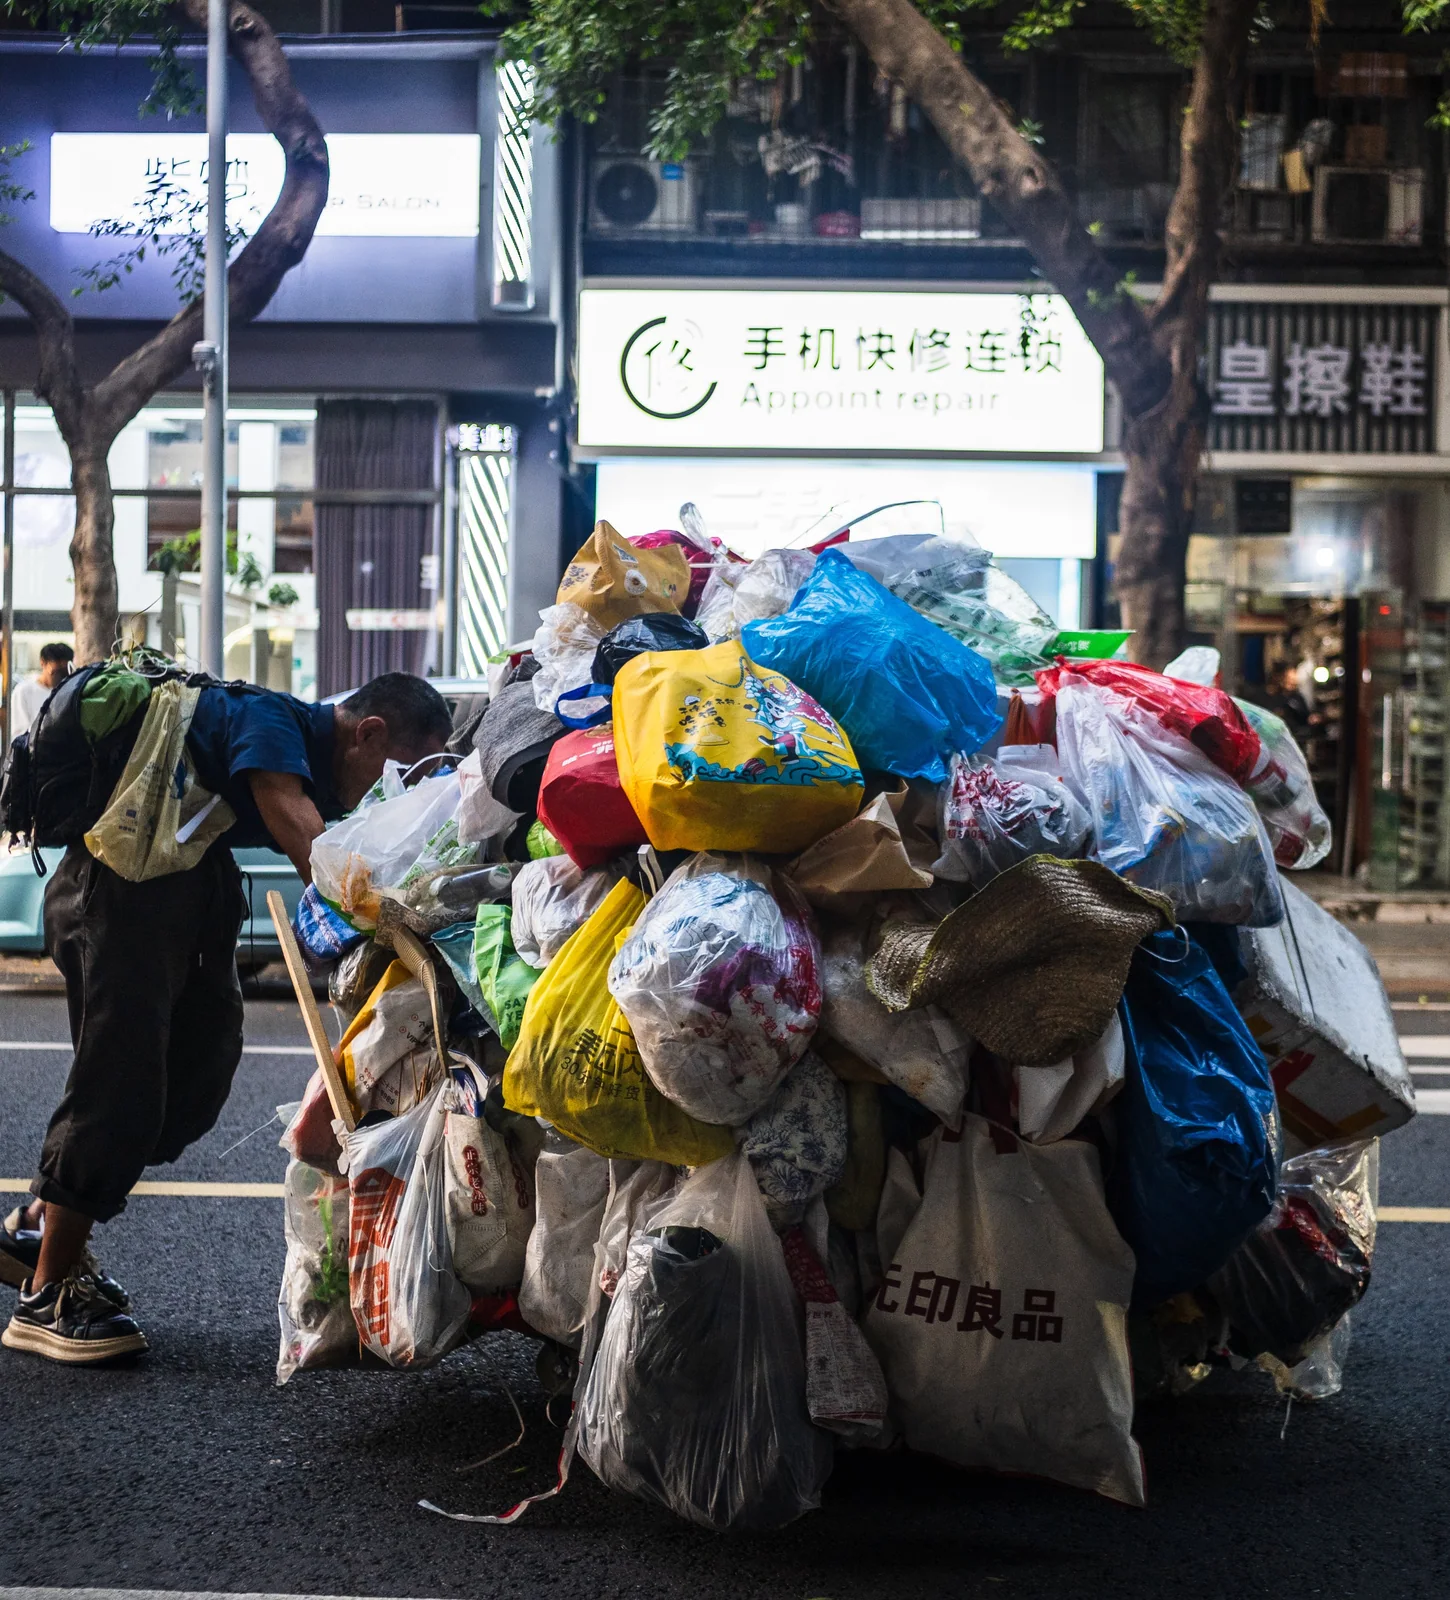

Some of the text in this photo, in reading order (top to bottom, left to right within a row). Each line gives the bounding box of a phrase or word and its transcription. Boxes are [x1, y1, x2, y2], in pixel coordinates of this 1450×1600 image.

[744, 327, 1062, 373] 手机快修连锁
[741, 382, 999, 416] Appoint repair
[505, 1010, 524, 1023] YE
[569, 1028, 650, 1084] 美团闪
